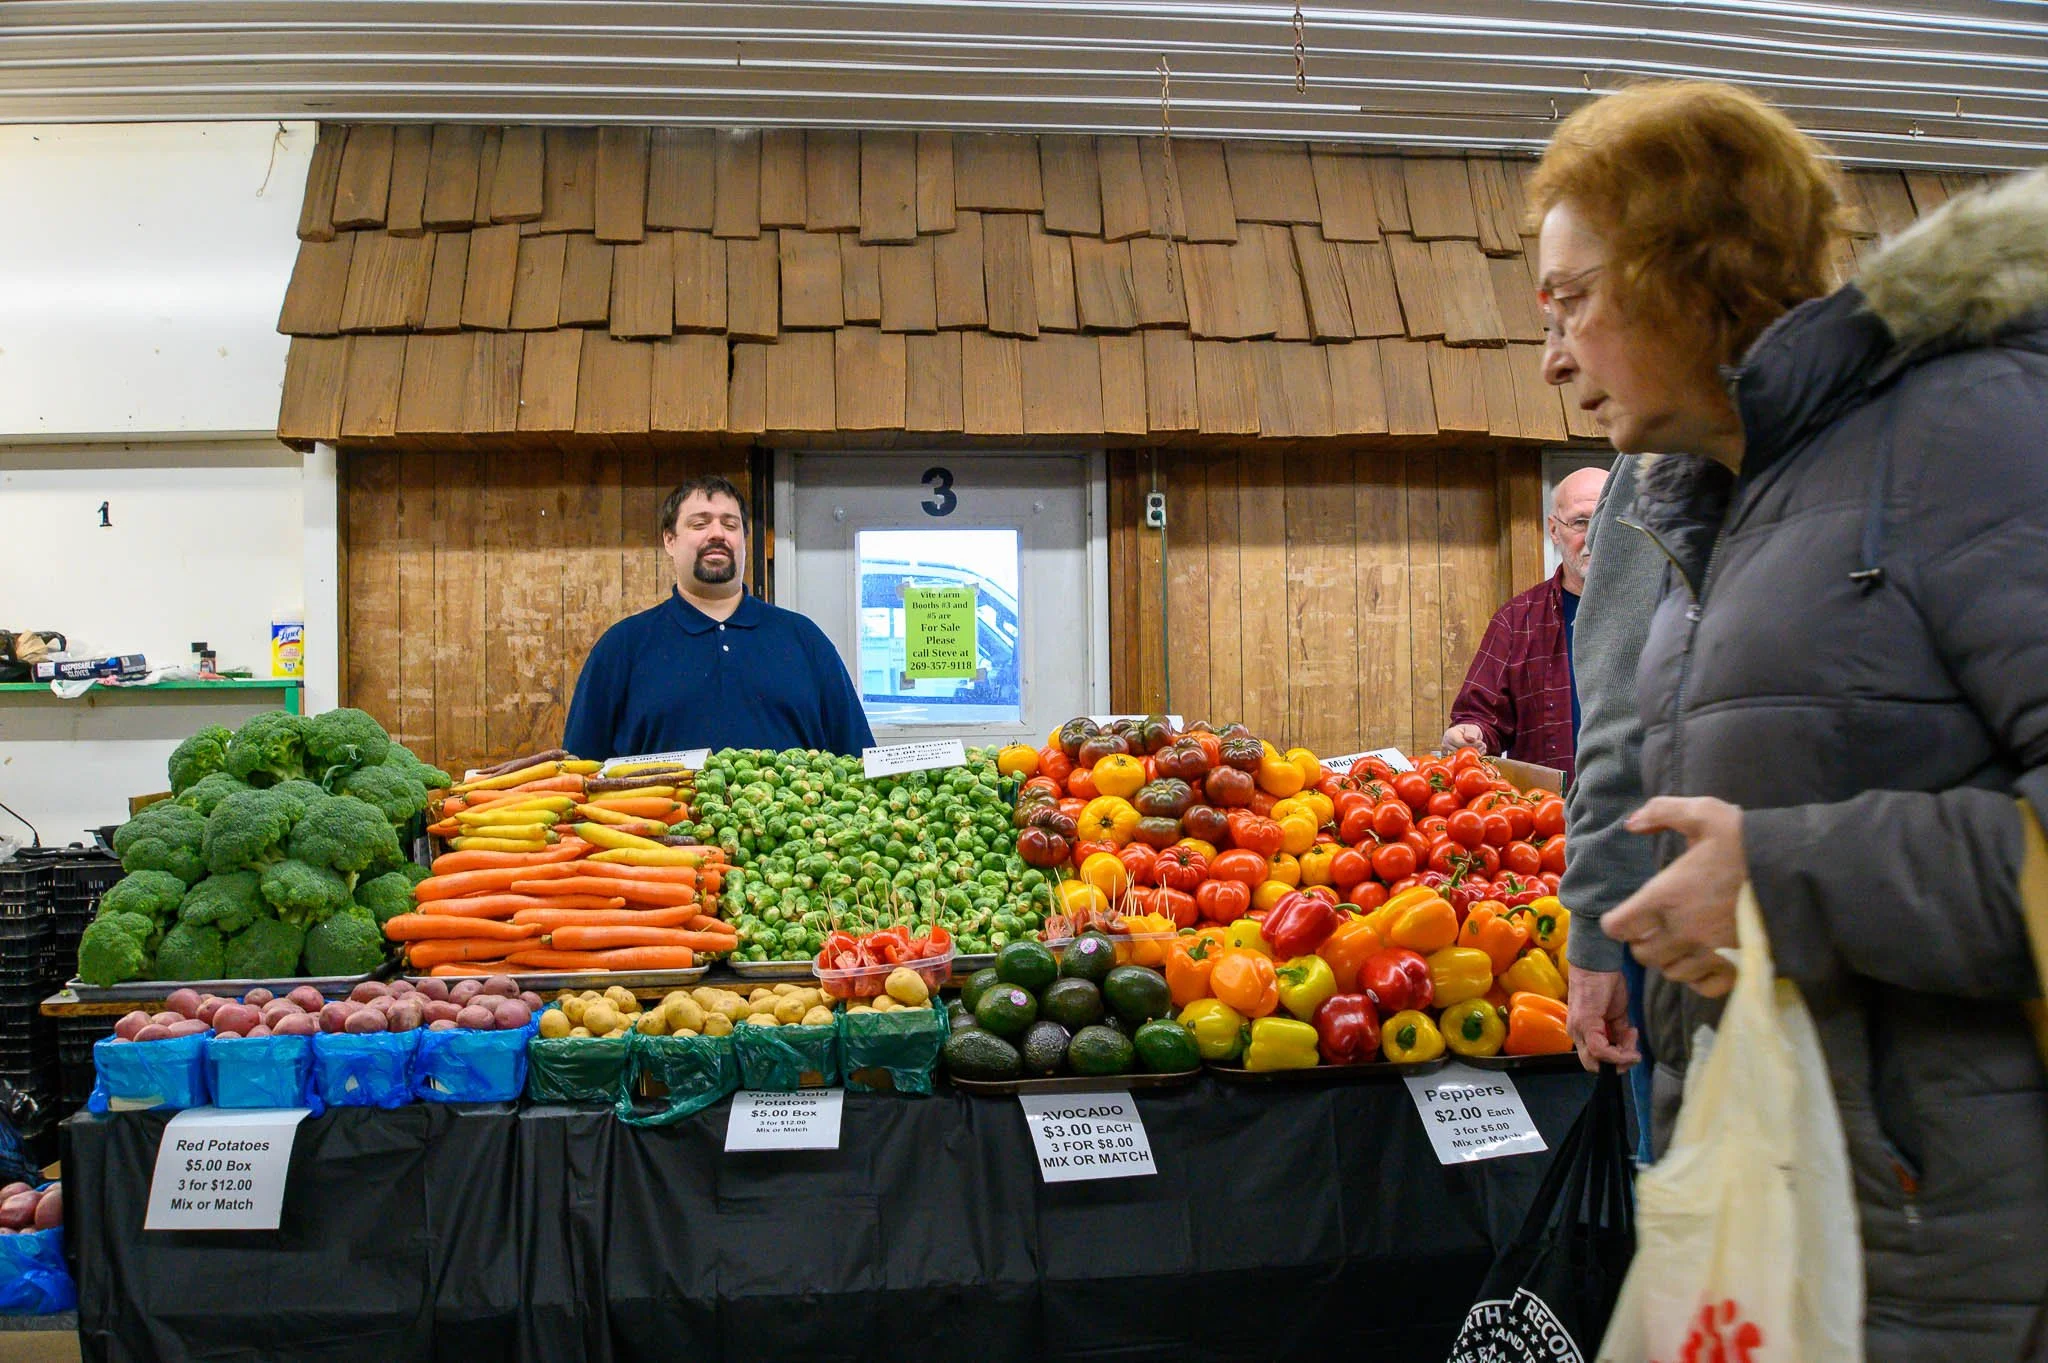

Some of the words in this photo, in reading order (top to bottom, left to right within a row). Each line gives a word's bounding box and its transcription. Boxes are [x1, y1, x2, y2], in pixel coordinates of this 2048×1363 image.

[920, 467, 958, 517] 3
[97, 501, 113, 527] 1
[953, 601, 968, 609] and
[921, 623, 938, 632] For
[940, 623, 960, 632] Sale
[280, 628, 299, 641] Lysol
[926, 636, 956, 645] Please
[912, 648, 929, 657] call
[931, 649, 957, 657] Steve
[910, 661, 972, 671] 269-357-9118
[1424, 1085, 1505, 1102] Peppers
[750, 1110, 788, 1118] $5.00
[1041, 1105, 1124, 1121] AVOCADO
[1435, 1106, 1482, 1123] $2.00
[1487, 1107, 1515, 1117] Each
[1043, 1123, 1092, 1139] $3.00
[1096, 1123, 1133, 1134] EACH
[1453, 1127, 1461, 1136] 3
[1462, 1126, 1479, 1135] for
[1480, 1122, 1510, 1133] $5.00
[176, 1140, 204, 1151] Red
[207, 1140, 270, 1151] Potatoes
[1051, 1143, 1060, 1153] 3
[1064, 1140, 1095, 1152] FOR
[1097, 1137, 1134, 1150] $8.00
[1452, 1140, 1473, 1148] Mix
[185, 1159, 222, 1172] $5.00
[226, 1160, 252, 1171] Box
[1043, 1156, 1070, 1168] MIX
[1073, 1155, 1096, 1166] OR
[1098, 1151, 1149, 1164] MATCH
[178, 1179, 186, 1191] 3
[189, 1179, 207, 1190] for
[210, 1179, 253, 1191] $12.00
[170, 1198, 193, 1210] Mix
[197, 1200, 211, 1210] or
[214, 1198, 253, 1210] Match
[1495, 1327, 1525, 1351] AND
